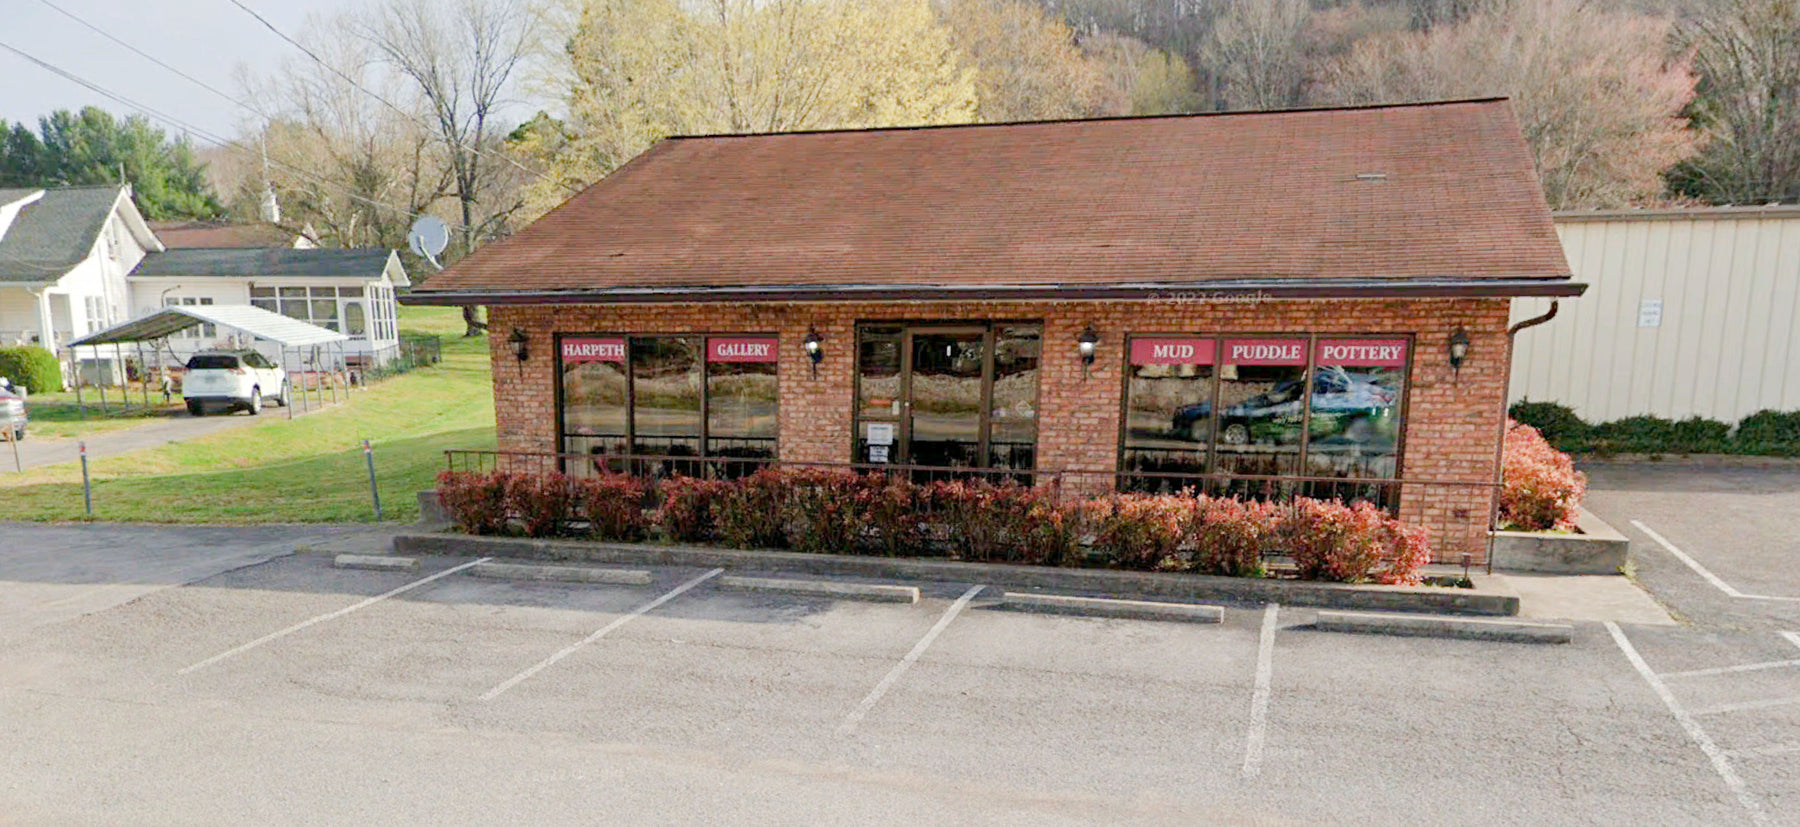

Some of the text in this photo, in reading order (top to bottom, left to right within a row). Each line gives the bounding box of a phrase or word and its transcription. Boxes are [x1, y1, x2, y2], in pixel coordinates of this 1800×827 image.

[563, 343, 770, 357] HARPETH GALLERY
[1153, 344, 1402, 360] MUD PUDDLE POTTERY
